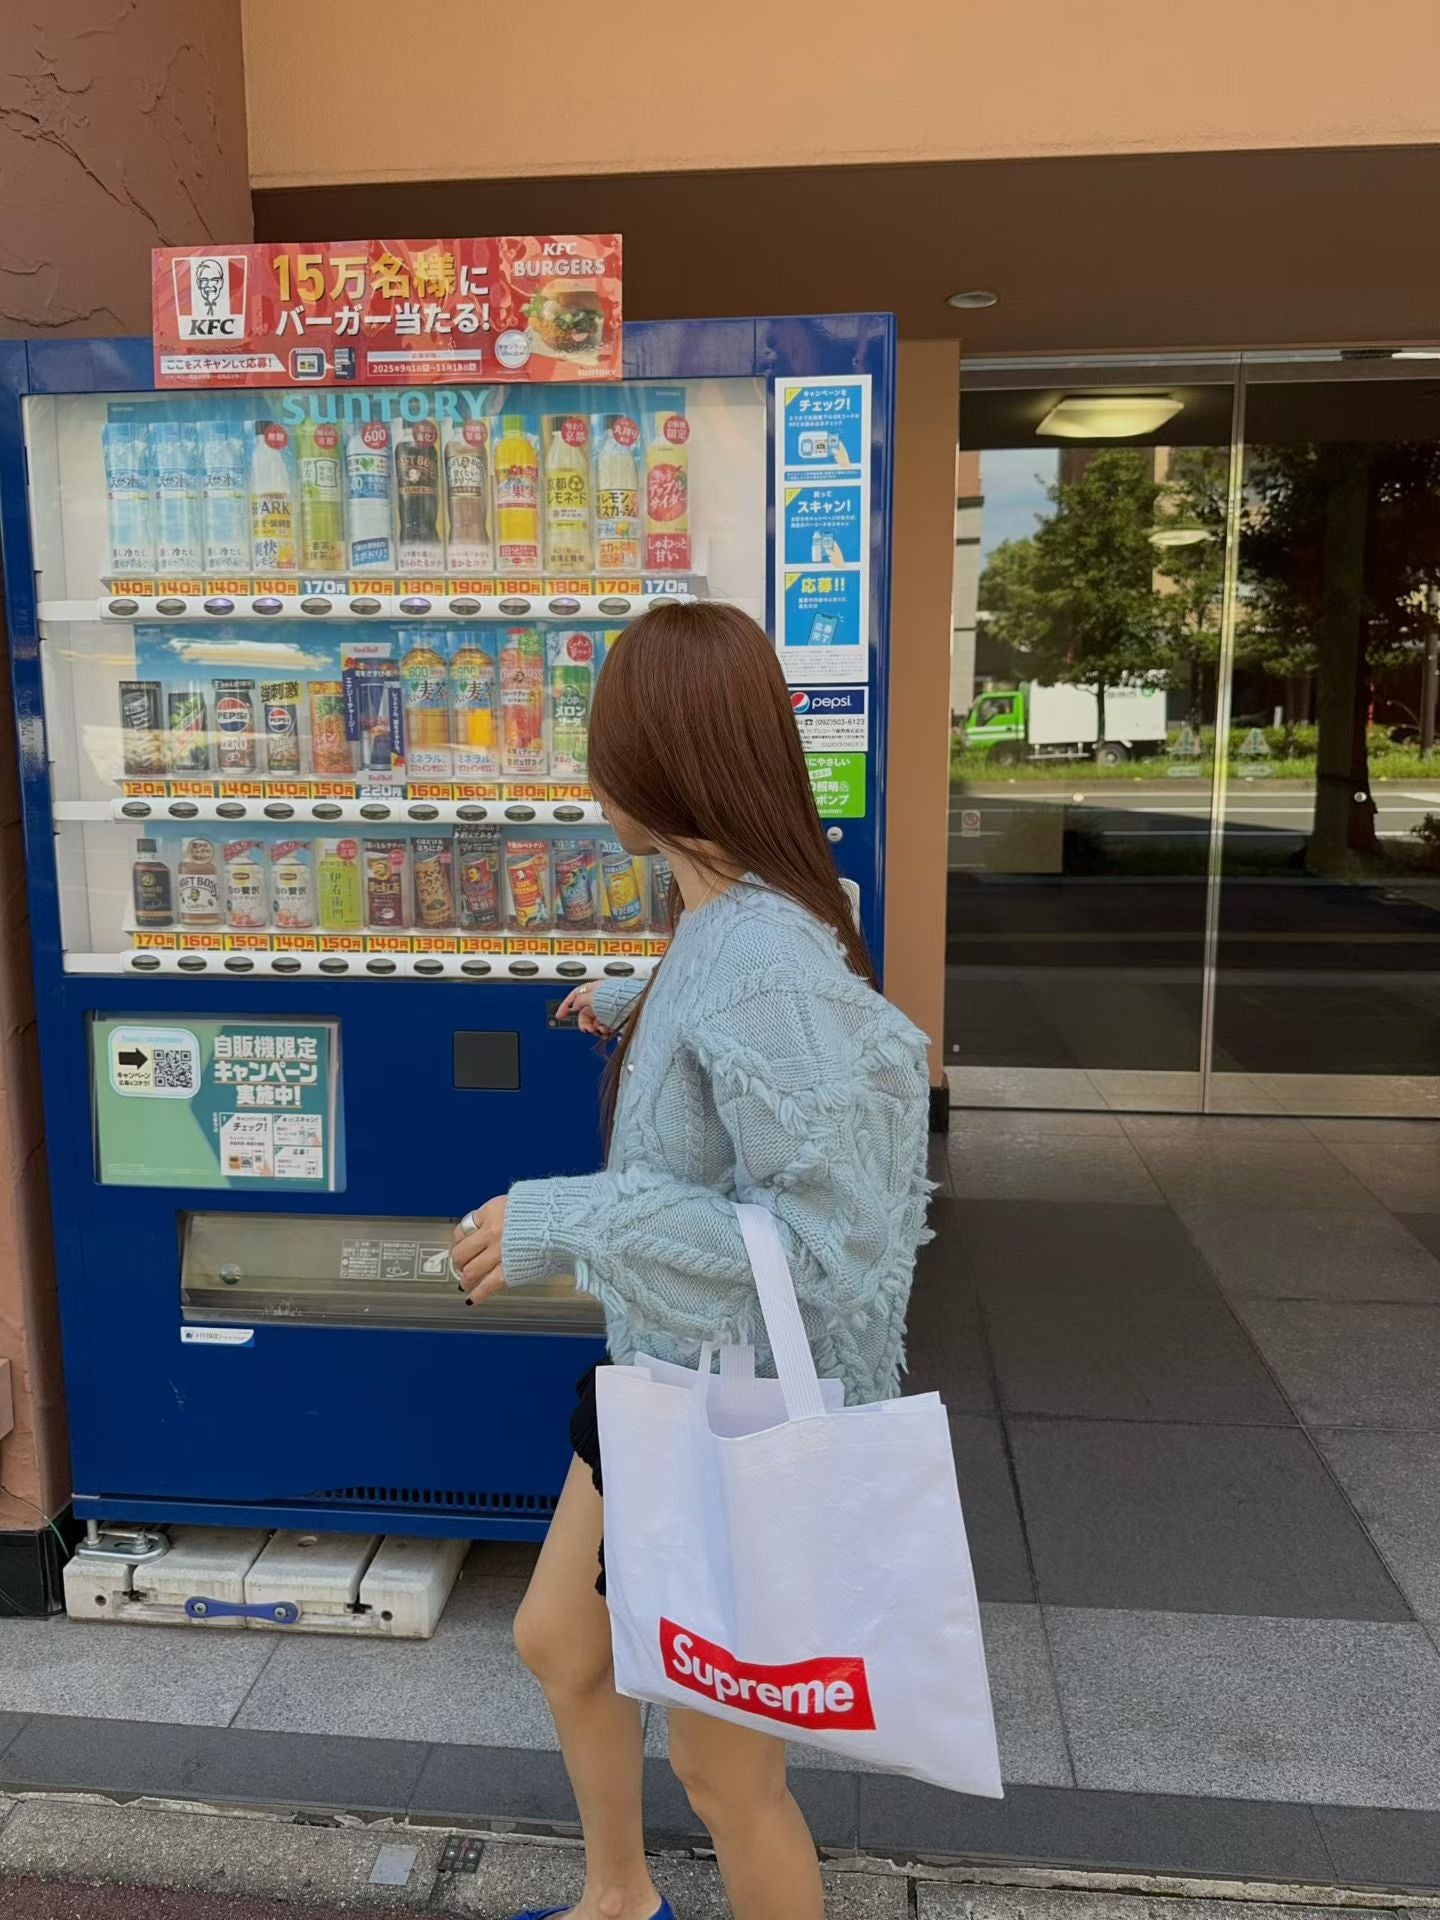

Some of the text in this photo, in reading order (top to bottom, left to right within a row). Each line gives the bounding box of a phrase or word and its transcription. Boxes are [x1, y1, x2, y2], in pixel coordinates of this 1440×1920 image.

[542, 242, 577, 255] KFC
[513, 256, 606, 278] BURGERS
[273, 253, 489, 303] 15万名様に
[275, 300, 491, 337] バーガー当たる!
[188, 317, 236, 336] KFC
[166, 357, 273, 371] ここをスキャンして応募!
[803, 389, 847, 398] キャンペーンを
[799, 399, 850, 412] チェック!
[364, 429, 385, 442] 600
[547, 491, 588, 505] レモネード
[602, 492, 629, 504] レモン
[798, 500, 851, 514] スキャン!
[648, 537, 688, 550] しゅわっと
[655, 549, 679, 562] 甘い
[113, 581, 152, 595] 140円
[160, 581, 200, 595] 140円
[208, 581, 249, 595] 140円
[256, 581, 297, 595] 140円
[304, 580, 347, 594] 170円
[352, 581, 393, 594] 170円
[450, 581, 492, 594] 190円
[499, 581, 541, 594] 180円
[599, 581, 640, 594] 170円
[645, 579, 688, 594] 170円
[420, 680, 448, 702] 麦茶
[469, 680, 496, 702] 麦茶
[812, 695, 852, 710] pepsi
[217, 712, 248, 721] PEPSI
[555, 705, 586, 718] メロン
[269, 716, 290, 724] PEPSI
[808, 757, 851, 767] にやさしい
[125, 782, 164, 795] 120円
[171, 782, 212, 795] 140円
[220, 782, 261, 795] 140円
[268, 783, 308, 796] 140円
[316, 783, 354, 796] 150円
[361, 785, 401, 797] 220円
[410, 784, 450, 797] 160円
[456, 784, 497, 797] 160円
[551, 785, 593, 797] 170円
[136, 934, 175, 946] 170円
[182, 935, 221, 947] 160円
[229, 935, 268, 947] 150円
[276, 936, 316, 948] 140円
[322, 936, 361, 948] 150円
[370, 936, 409, 948] 140円
[416, 938, 456, 950] 130円
[463, 938, 504, 951] 130円
[509, 939, 549, 951] 130円
[556, 940, 596, 952] 120円
[603, 940, 643, 953] 120円
[213, 1035, 318, 1060] 自販機限定
[214, 1060, 318, 1083] キャンペーン
[236, 1084, 301, 1106] 実施中!
[233, 1122, 268, 1132] チェック!
[672, 1633, 854, 1715] Supreme
